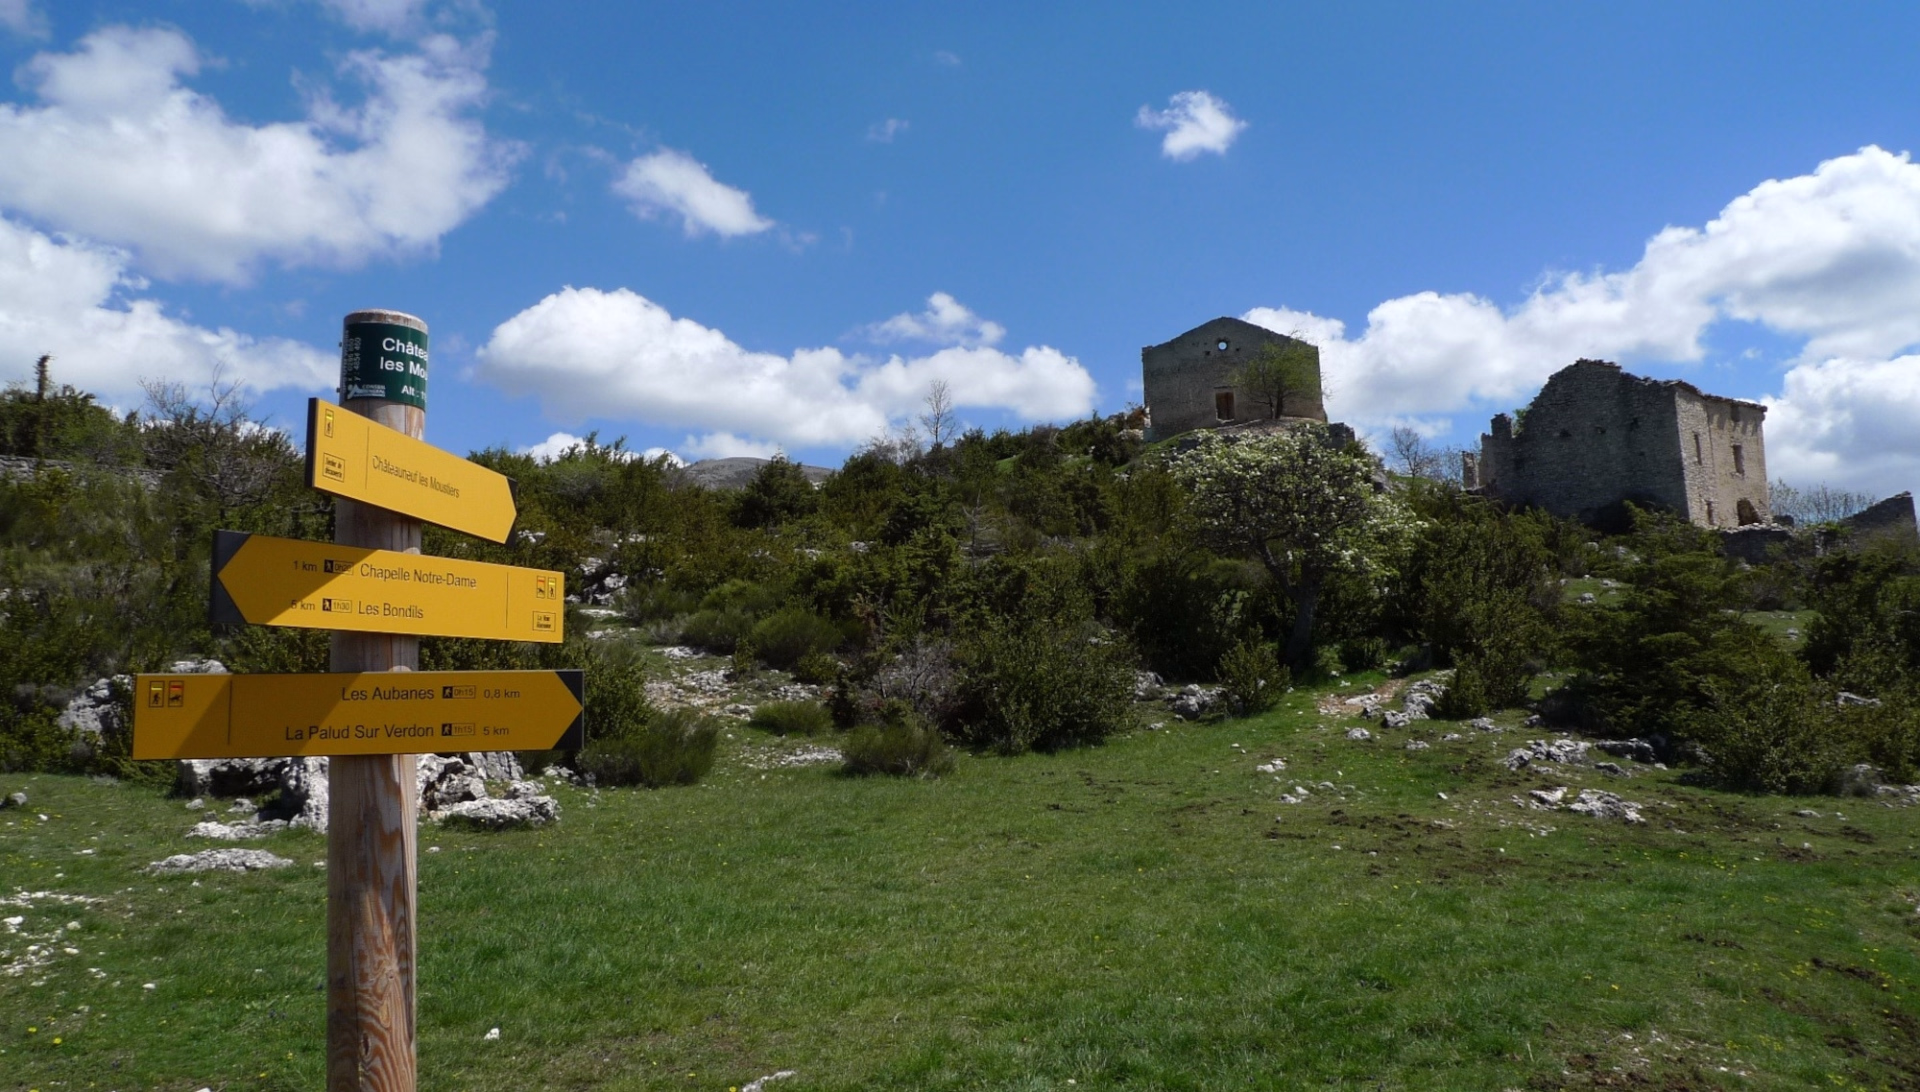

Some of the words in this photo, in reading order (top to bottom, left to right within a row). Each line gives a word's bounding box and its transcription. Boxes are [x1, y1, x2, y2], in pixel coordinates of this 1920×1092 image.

[380, 356, 404, 372] les
[372, 455, 418, 484] Châteauneuf
[418, 472, 428, 487] les
[429, 476, 460, 498] Moustiers
[293, 560, 298, 570] 1
[302, 560, 317, 572] km
[360, 563, 410, 582] Chapelle
[413, 569, 477, 588] Notre-Dame
[300, 600, 316, 611] km
[333, 601, 350, 610] 1h30
[358, 600, 379, 616] Les
[383, 602, 424, 619] Bondils
[341, 687, 368, 701] Les
[372, 686, 435, 700] Aubanes
[454, 688, 474, 697] 0h15
[483, 689, 501, 699] 0,8
[504, 688, 520, 698] km
[285, 726, 304, 740] La
[308, 725, 350, 740] Palud
[354, 724, 379, 739] Sur
[384, 723, 434, 738] Verdon
[455, 726, 473, 735] 1h15
[483, 726, 490, 735] 5
[493, 725, 509, 735] km
